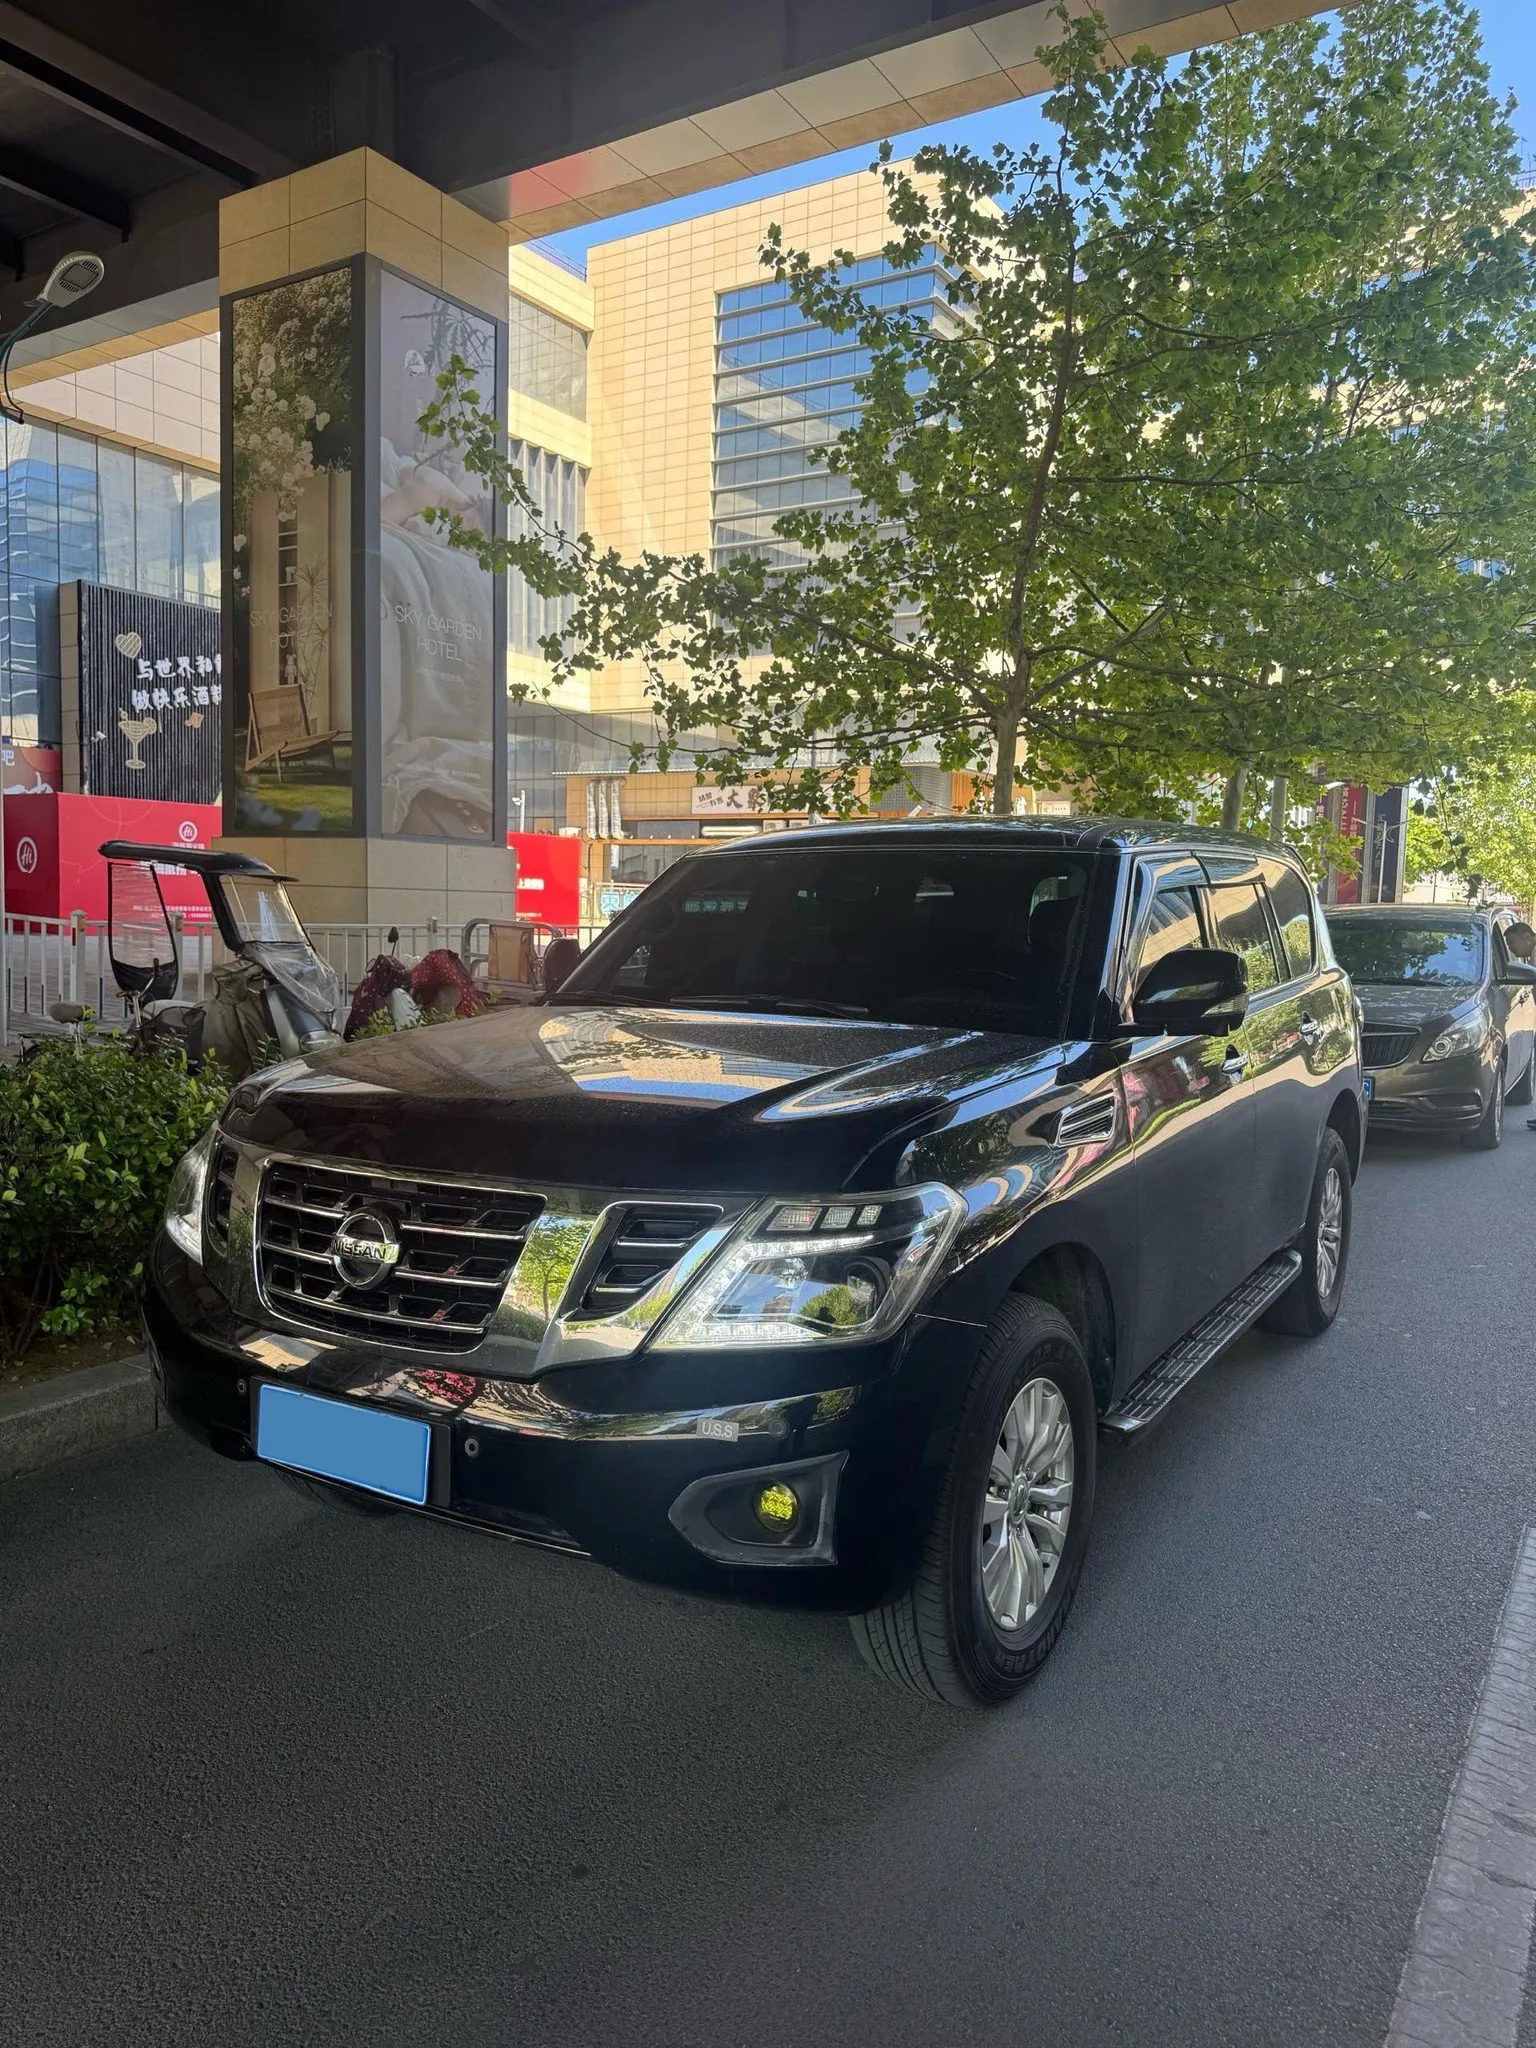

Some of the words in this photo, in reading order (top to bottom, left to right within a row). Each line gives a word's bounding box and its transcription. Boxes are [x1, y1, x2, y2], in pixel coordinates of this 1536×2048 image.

[395, 605, 423, 625] SKY
[427, 614, 482, 642] GARDEN
[417, 637, 463, 662] HOTEL
[333, 1238, 387, 1261] NISSAN
[701, 1421, 733, 1438] U.S.S
